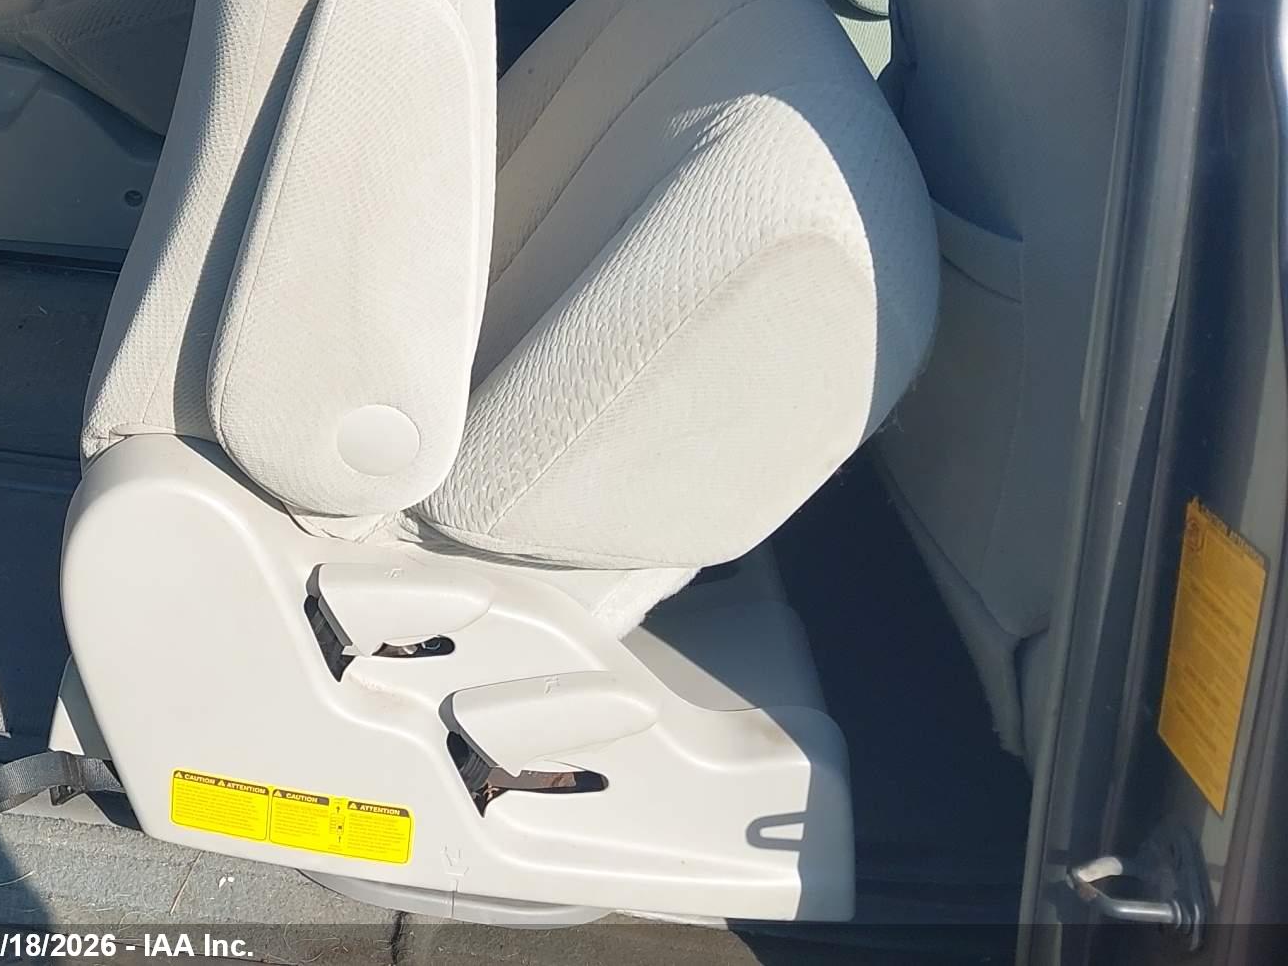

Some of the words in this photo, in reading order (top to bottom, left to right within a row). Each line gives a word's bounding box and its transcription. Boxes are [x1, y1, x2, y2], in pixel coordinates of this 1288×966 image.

[184, 773, 216, 784] CAUTION
[227, 782, 266, 794] ATTENTION
[285, 792, 318, 803] CAUTION
[359, 804, 401, 816] ATTENTION
